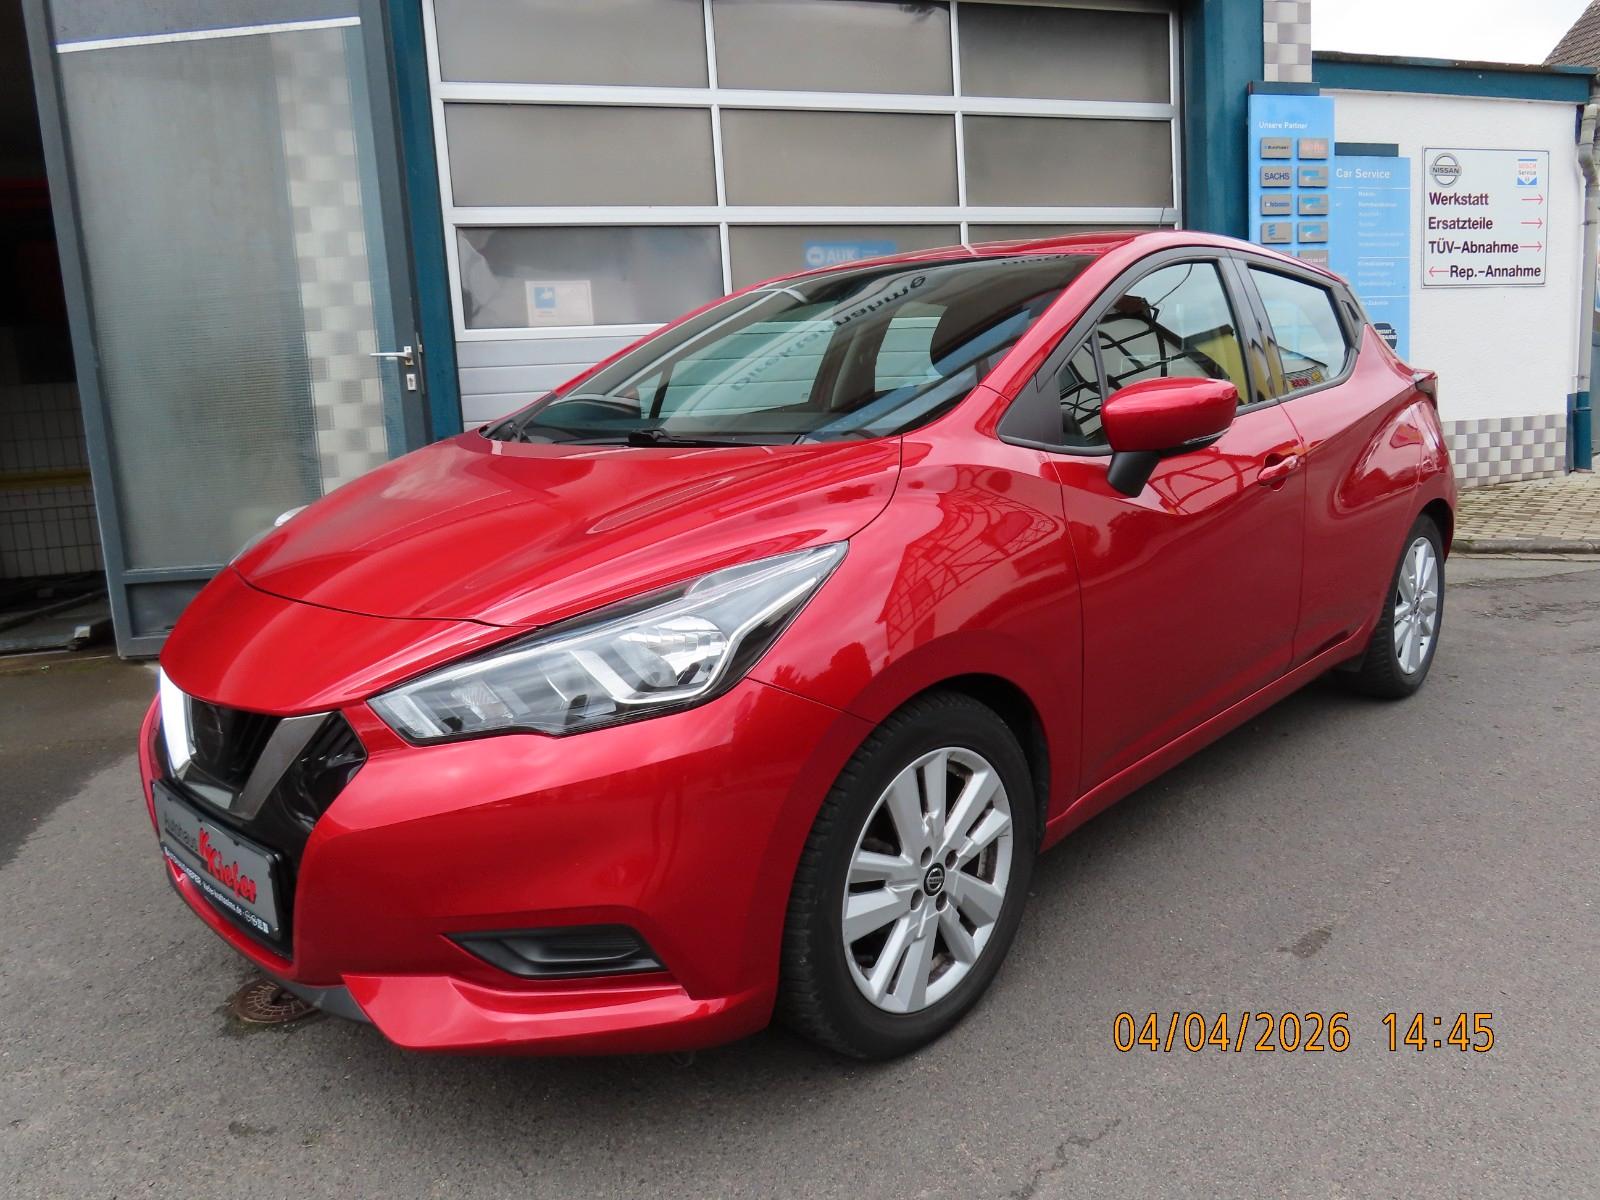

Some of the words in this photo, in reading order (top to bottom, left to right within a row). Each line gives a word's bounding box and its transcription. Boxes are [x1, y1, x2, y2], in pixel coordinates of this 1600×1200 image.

[1259, 121, 1283, 129] Unsere
[1284, 121, 1308, 129] Partner
[1264, 172, 1290, 180] SACHS
[1336, 168, 1352, 178] Car
[1355, 168, 1391, 179] Service
[1429, 192, 1489, 205] Werkstatt
[1428, 216, 1493, 230] Ersatzteile
[1429, 238, 1519, 254] TÜV-Abnahme
[1450, 265, 1541, 280] Rep.-Annahme
